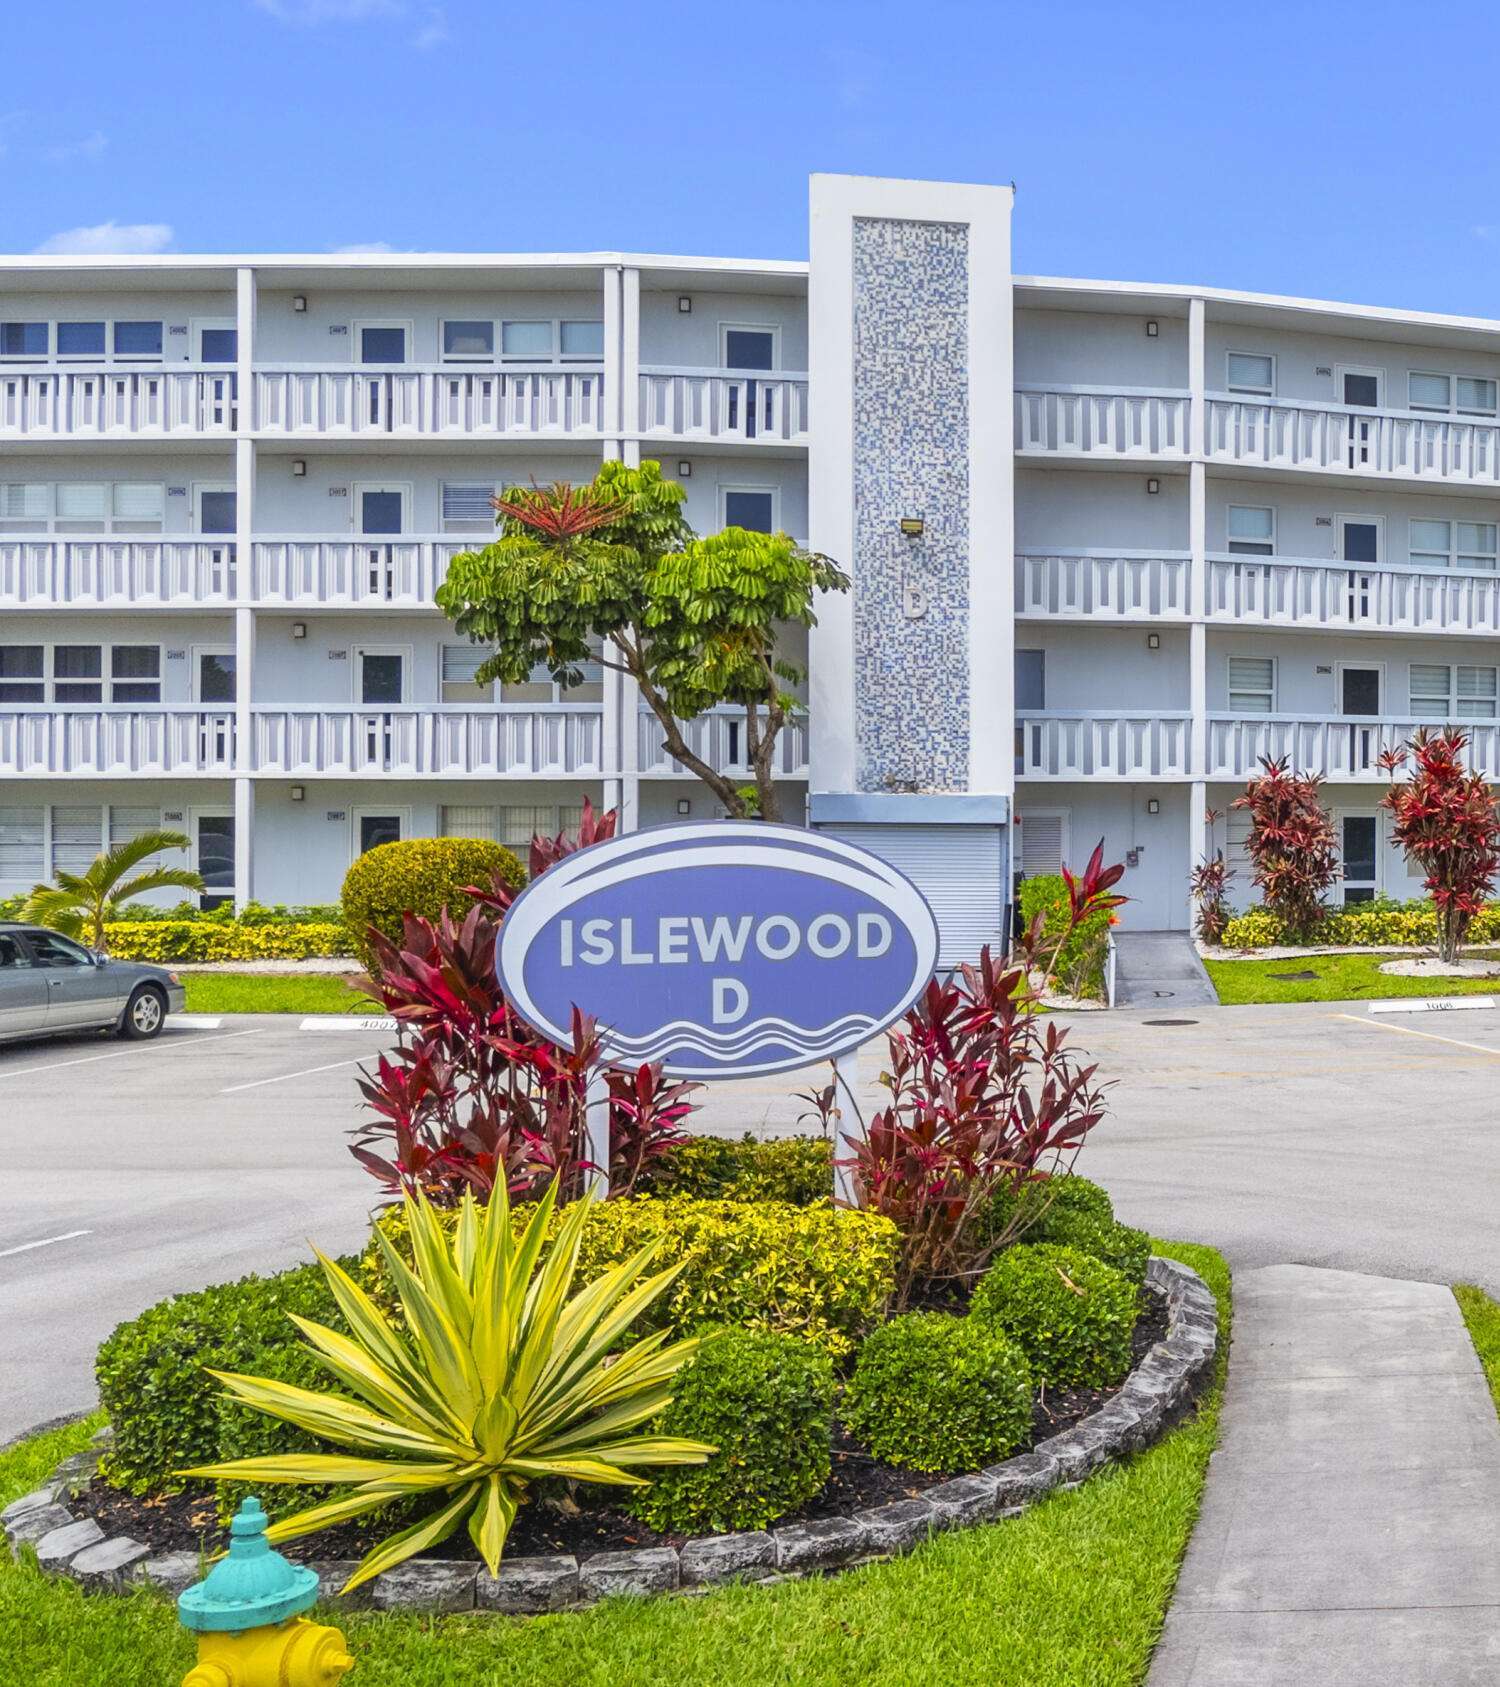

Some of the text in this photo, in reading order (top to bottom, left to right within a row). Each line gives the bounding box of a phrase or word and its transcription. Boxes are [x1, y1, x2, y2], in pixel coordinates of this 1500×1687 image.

[904, 587, 928, 618] D
[561, 913, 892, 966] ISLEWOOD
[713, 978, 749, 1024] D
